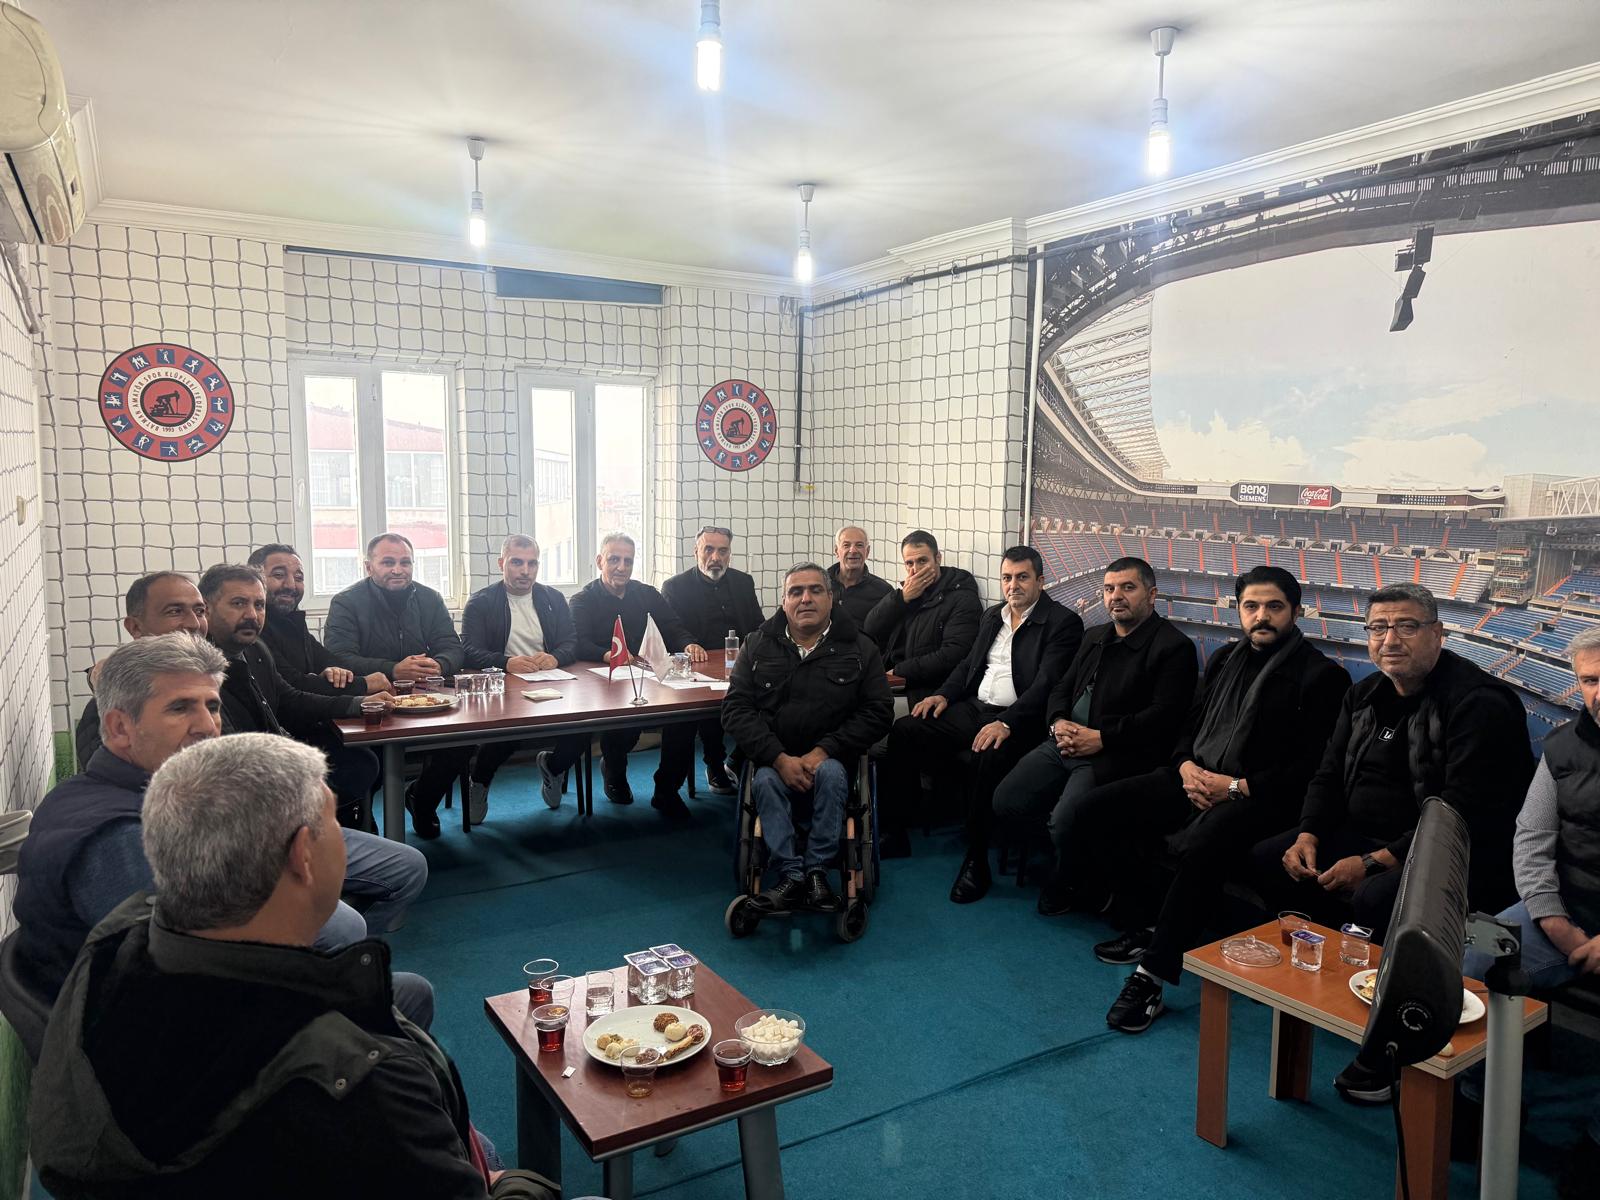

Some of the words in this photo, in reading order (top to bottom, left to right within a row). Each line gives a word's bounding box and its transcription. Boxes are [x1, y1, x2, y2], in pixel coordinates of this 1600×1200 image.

[143, 371, 162, 382] SPOR
[132, 381, 145, 408] AMATÖR
[135, 410, 160, 432] BATMAN
[1240, 484, 1268, 496] BenQ
[1239, 494, 1266, 503] SIEMENS
